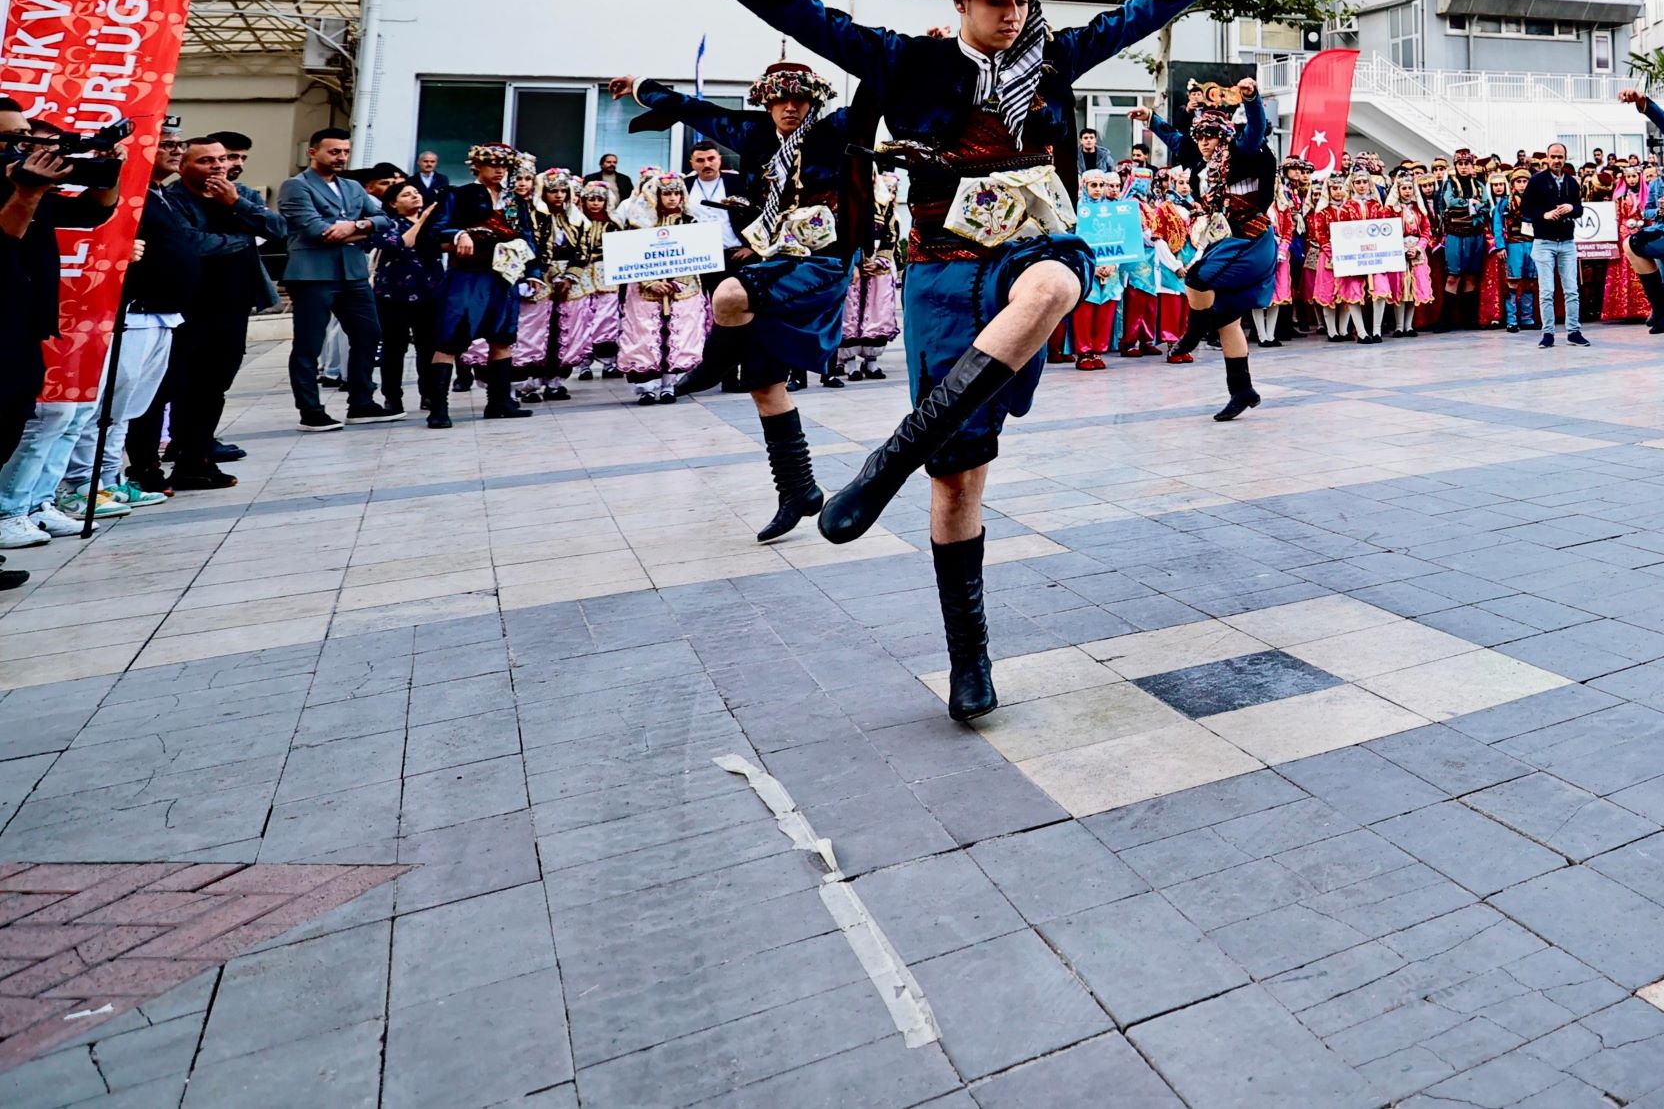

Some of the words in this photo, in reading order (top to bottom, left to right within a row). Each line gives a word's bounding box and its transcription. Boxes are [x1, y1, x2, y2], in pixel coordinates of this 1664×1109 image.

[644, 245, 685, 260] DENİZLİ
[1093, 244, 1125, 258] ANA
[618, 259, 668, 273] BÜYÜKŞEHİR
[669, 254, 711, 267] BELEDİYESİ
[612, 272, 633, 282] HALK
[634, 267, 673, 279] OYUNLARI
